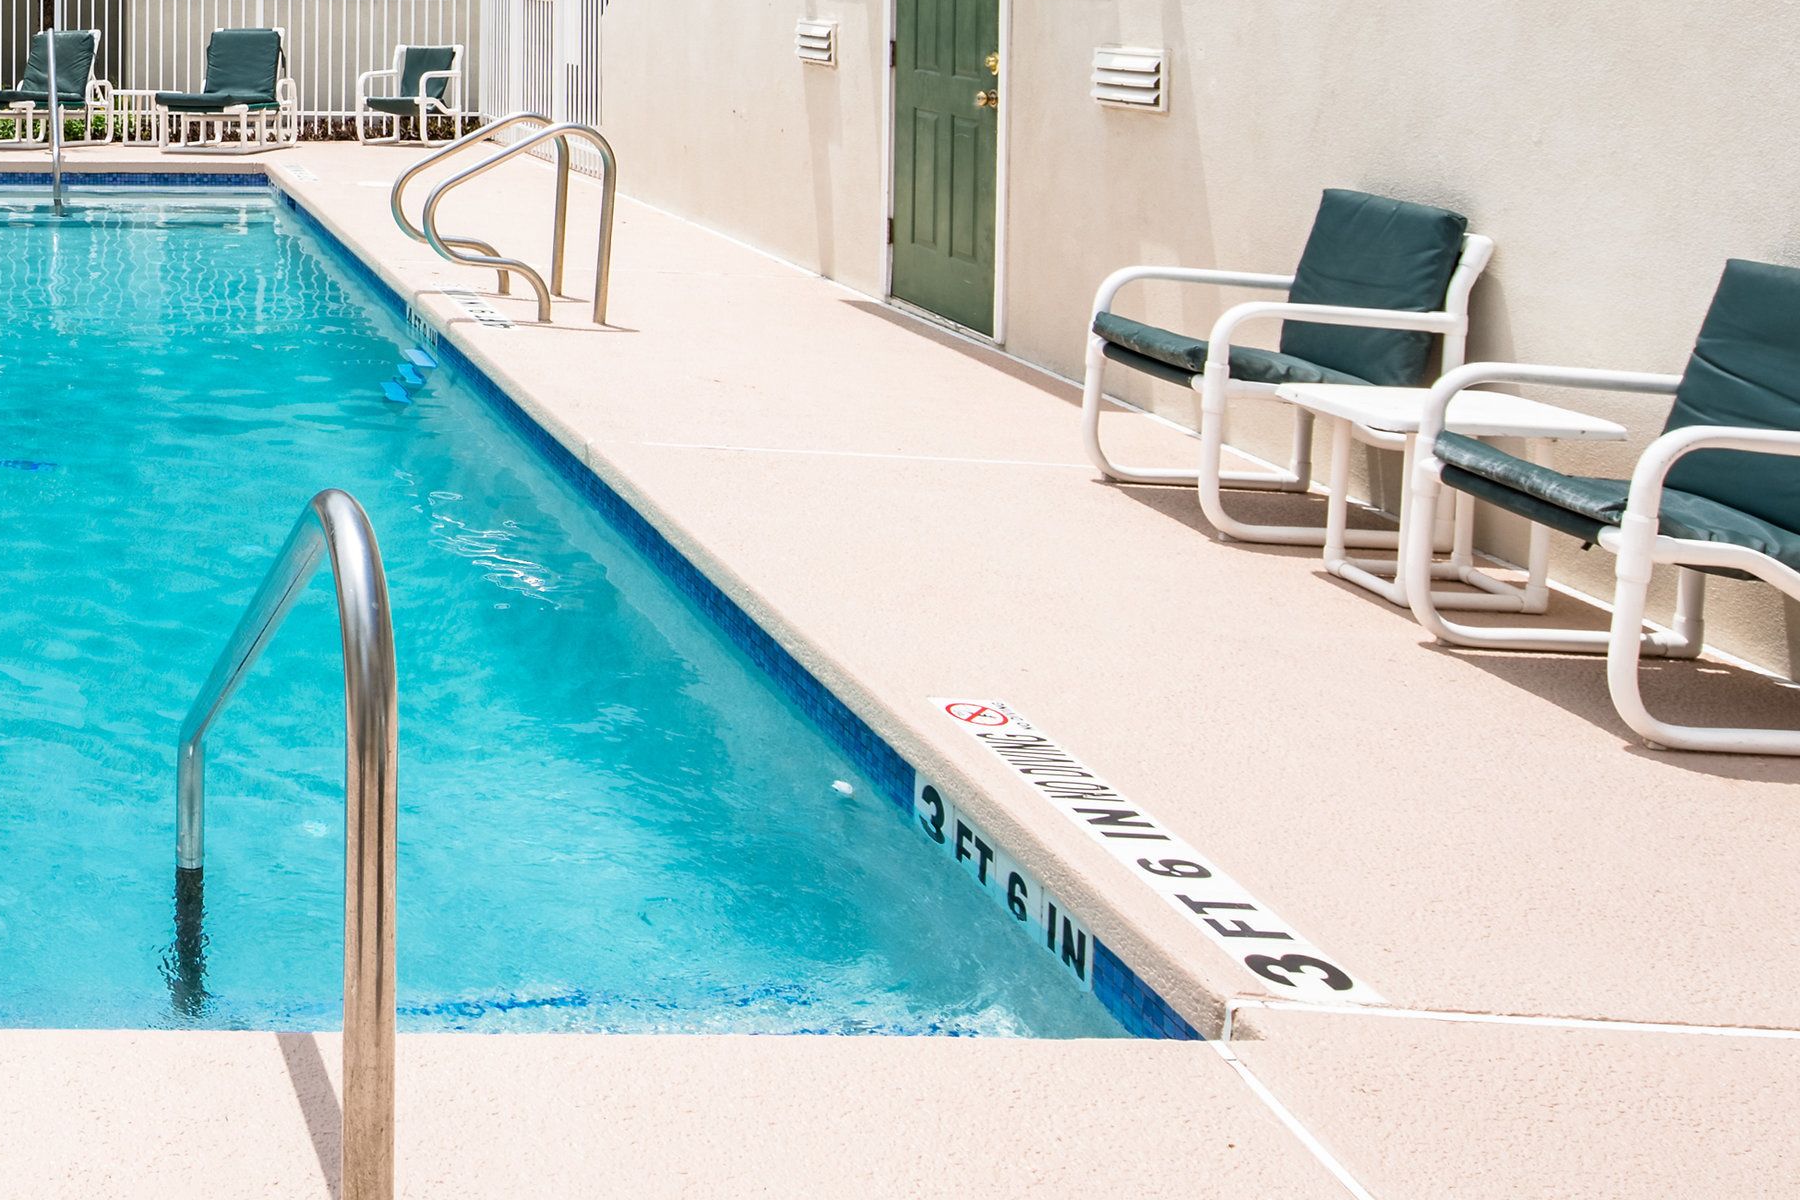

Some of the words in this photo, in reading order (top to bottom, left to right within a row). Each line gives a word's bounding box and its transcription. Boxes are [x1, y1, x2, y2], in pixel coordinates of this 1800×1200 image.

[976, 733, 1094, 778] DIVING
[1034, 780, 1125, 802] NO
[1071, 807, 1171, 841] IN
[920, 784, 945, 845] 3
[956, 818, 994, 887] FT
[1007, 871, 1027, 922] 6
[1047, 901, 1086, 982] IN
[1136, 858, 1212, 879] 6
[1174, 893, 1295, 941] FT
[1244, 953, 1354, 992] 3
